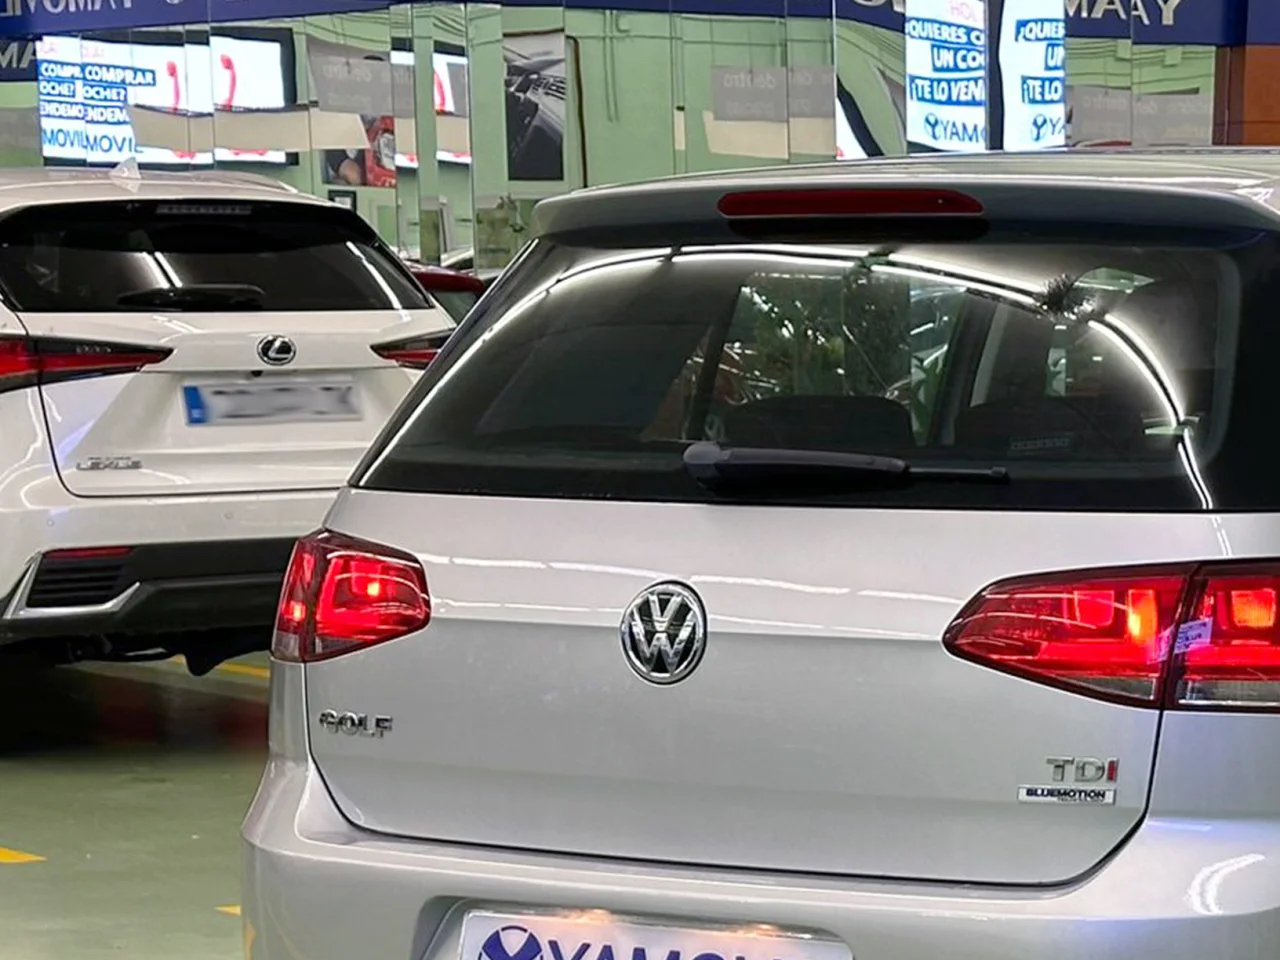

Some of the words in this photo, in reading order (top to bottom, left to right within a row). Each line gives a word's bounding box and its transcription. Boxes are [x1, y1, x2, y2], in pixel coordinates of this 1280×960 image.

[84, 65, 155, 85] COMPRAR
[319, 708, 393, 738] GOLF
[1045, 756, 1118, 782] TDI
[1026, 787, 1106, 799] BLUEMOTION
